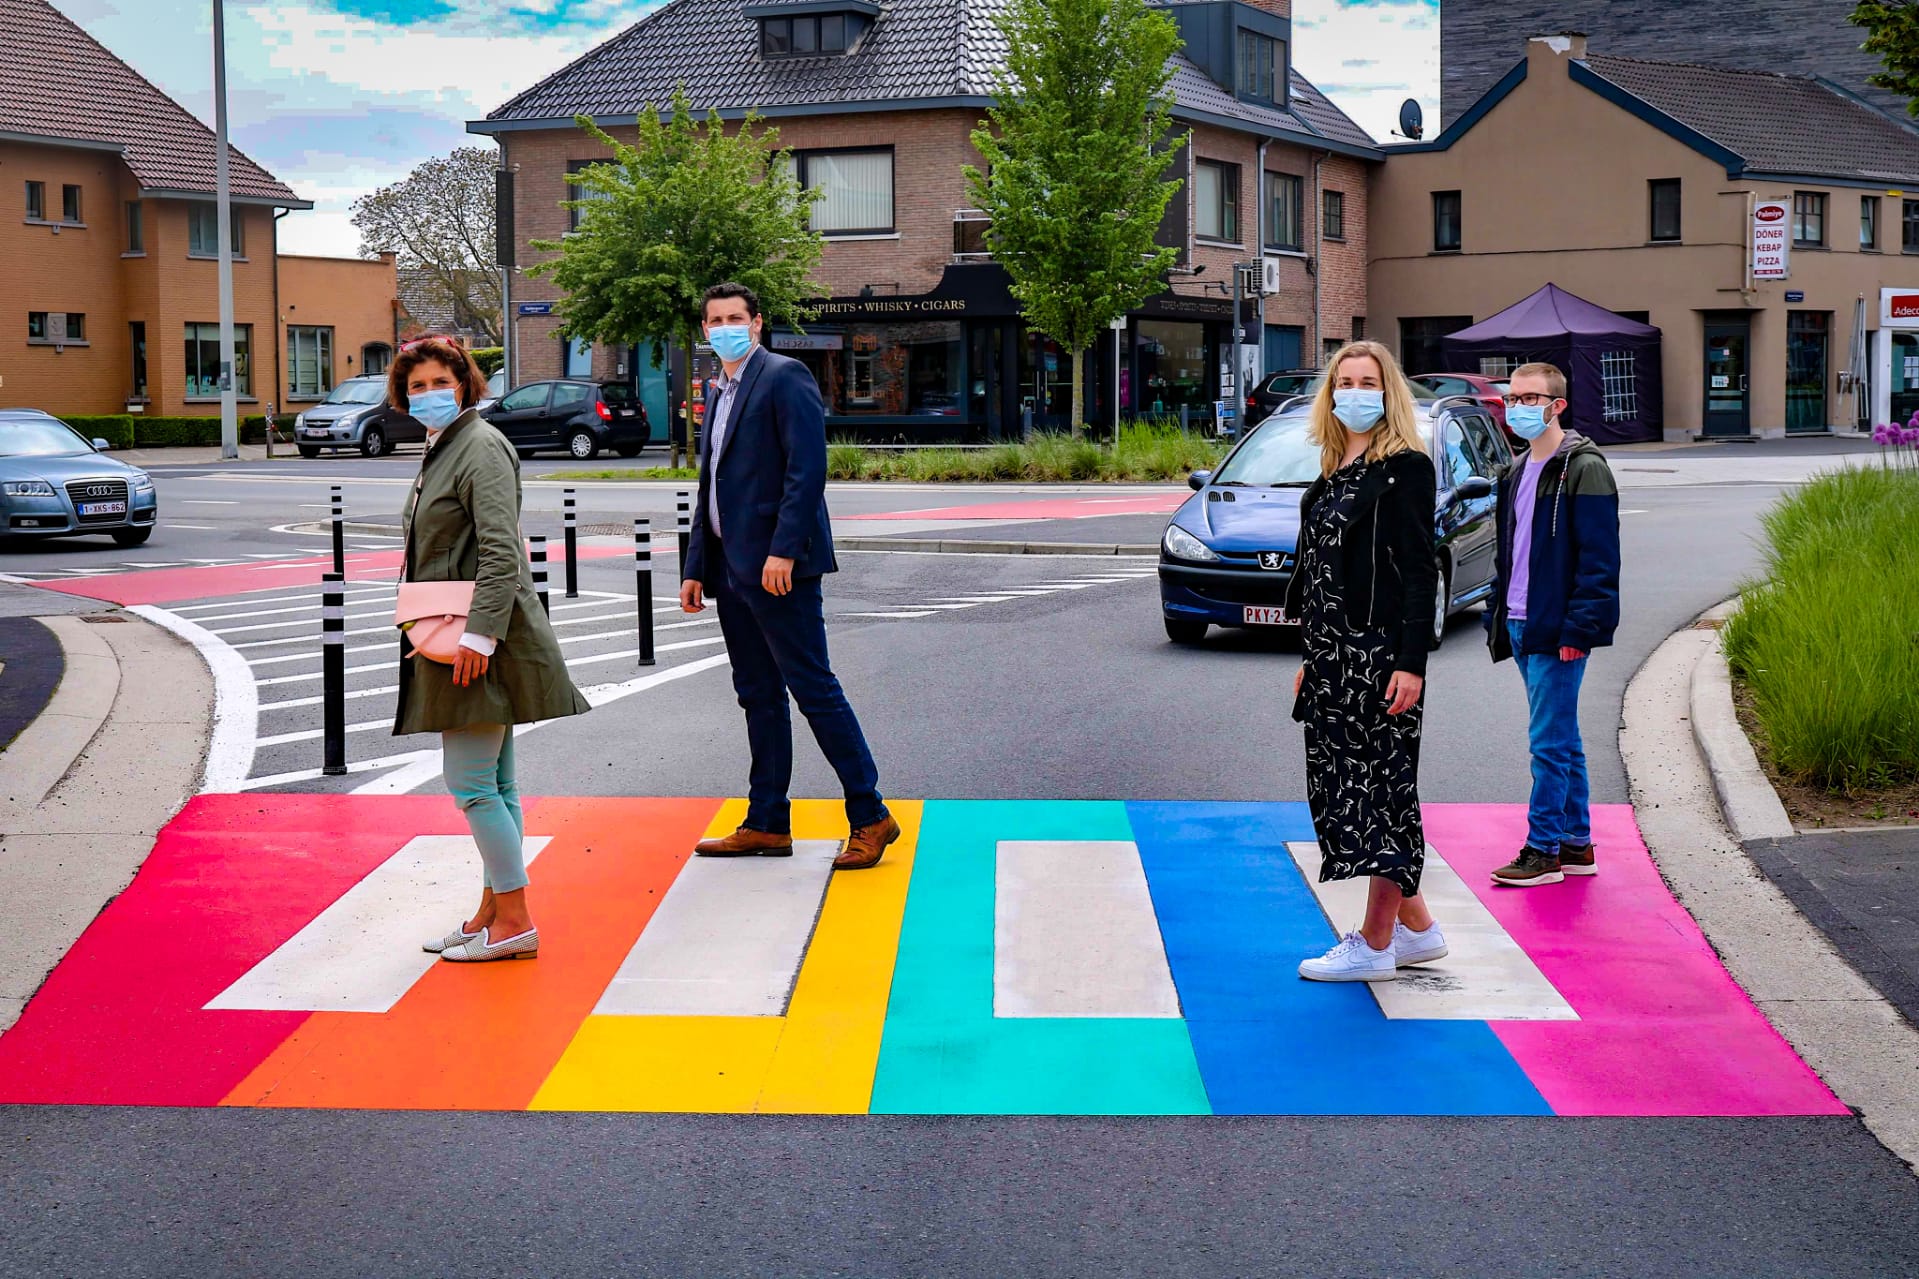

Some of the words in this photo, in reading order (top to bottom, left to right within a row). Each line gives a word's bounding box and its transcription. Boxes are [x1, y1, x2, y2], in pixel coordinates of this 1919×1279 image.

[1756, 229, 1783, 239] DÖNER
[1756, 243, 1782, 252] KEBAP
[1757, 257, 1780, 265] PIZZA
[812, 302, 856, 313] SPIRITS
[864, 301, 912, 312] WHISKY
[921, 299, 966, 311] CIGARS
